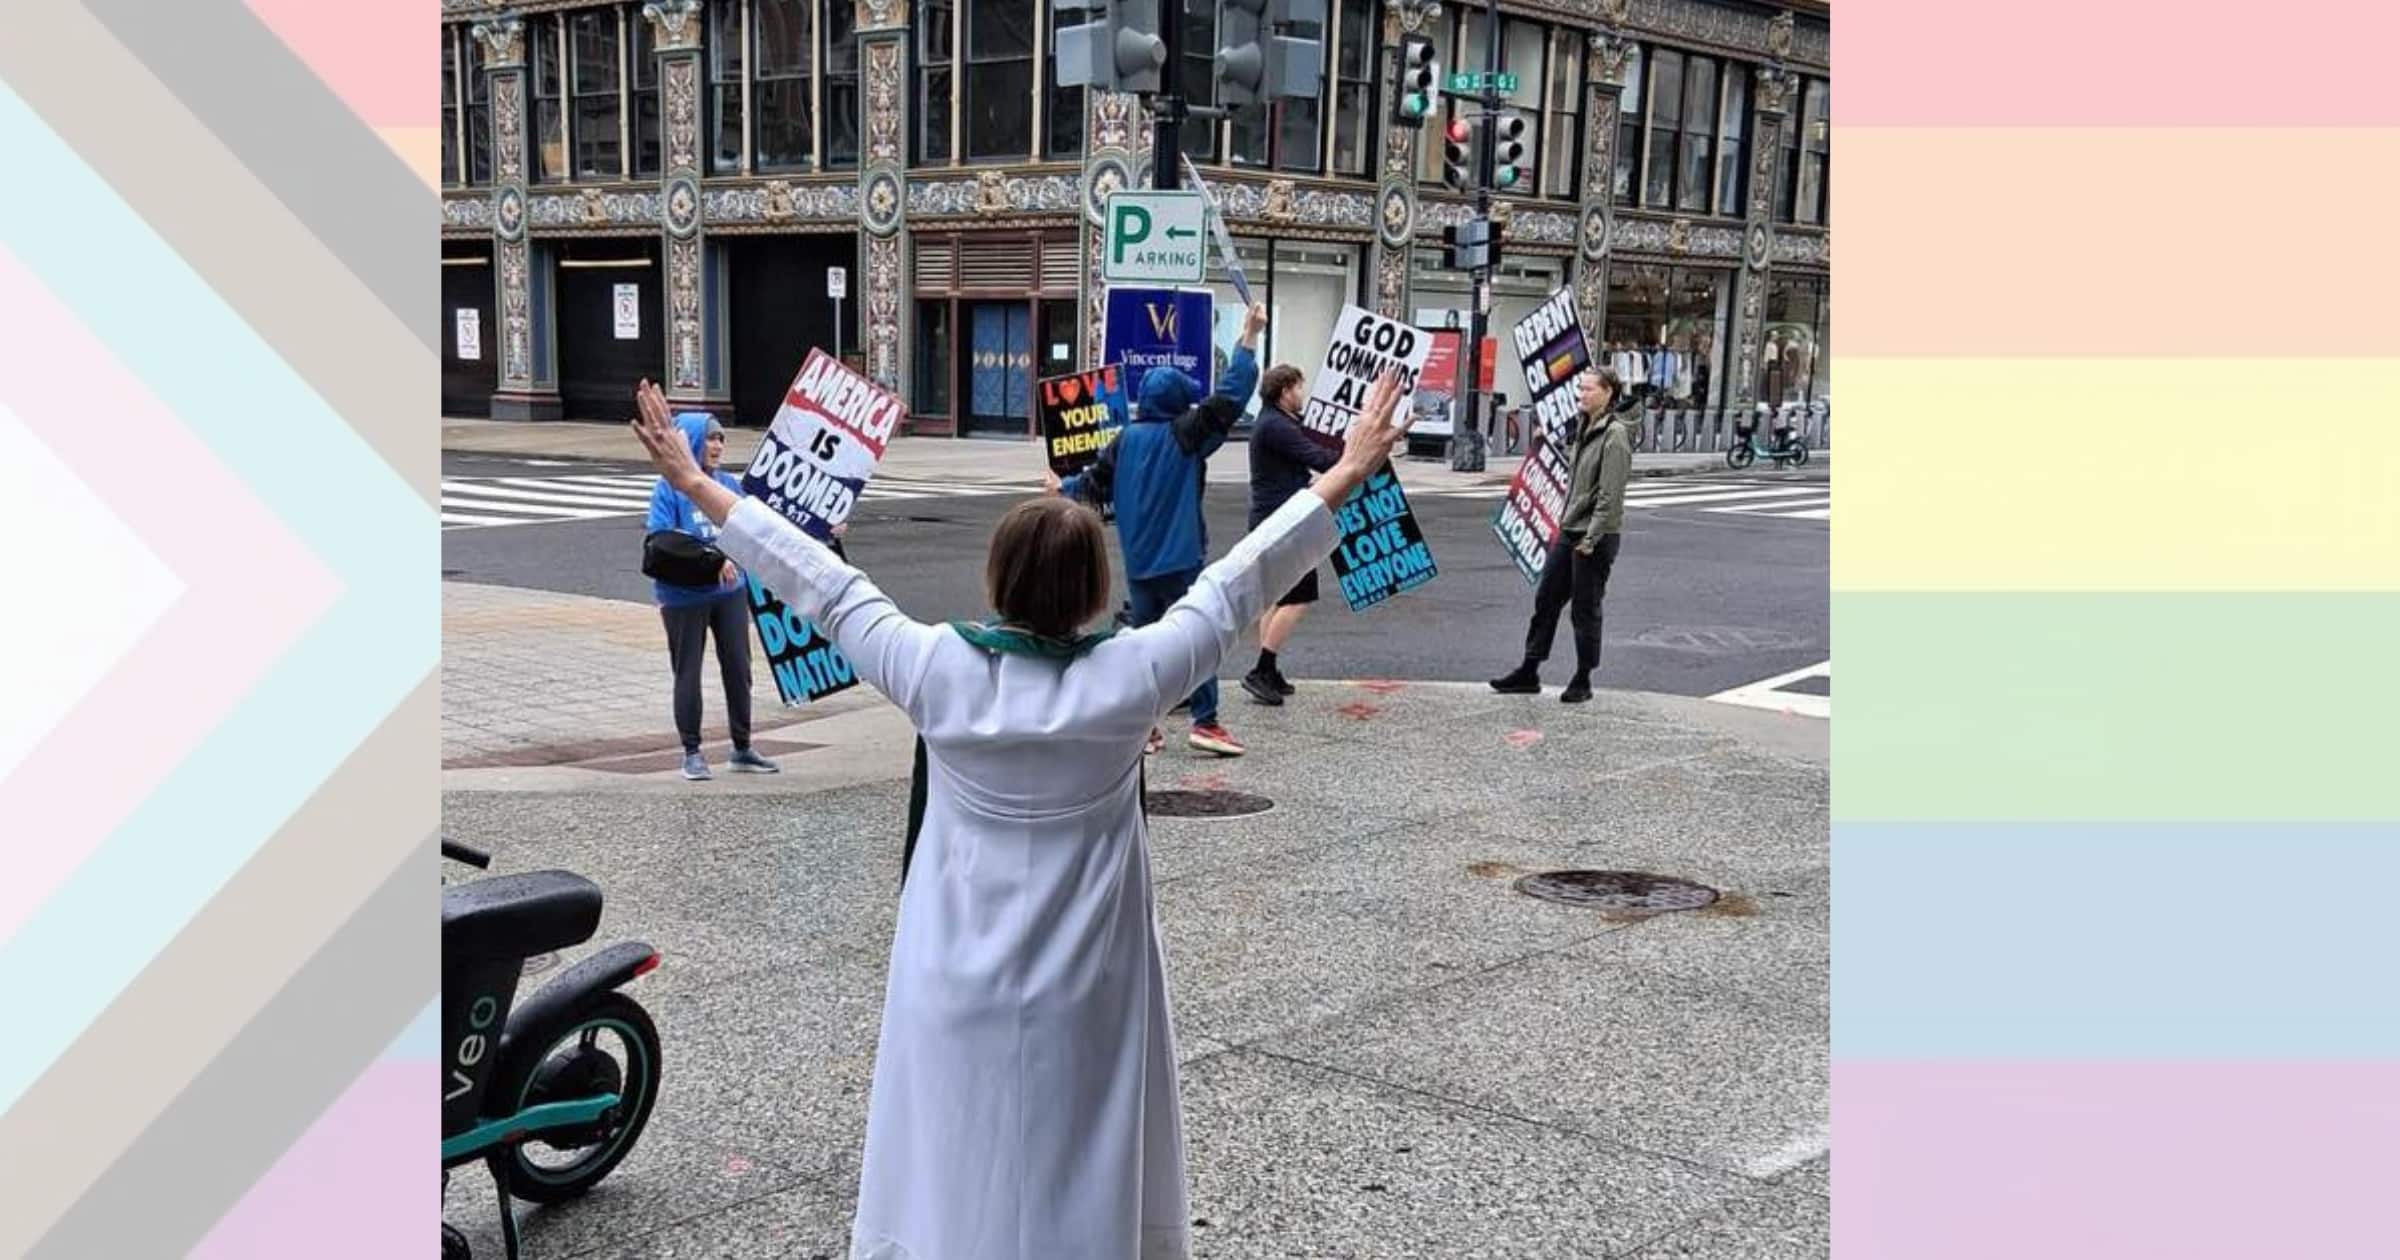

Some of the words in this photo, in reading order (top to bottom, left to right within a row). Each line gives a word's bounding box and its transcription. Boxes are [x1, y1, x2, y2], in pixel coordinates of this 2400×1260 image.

[1354, 315, 1416, 359] GOD
[1514, 289, 1575, 360] REPENT
[795, 353, 901, 447] AMERICA
[1526, 358, 1550, 394] OR
[1060, 403, 1110, 430] YOUR
[810, 428, 841, 462] IS
[750, 437, 854, 527] DOOMED
[1515, 487, 1532, 513] TO
[1551, 461, 1569, 491] NO
[1363, 483, 1407, 523] NOT
[1340, 520, 1408, 570] LOVE
[1500, 500, 1547, 573] WORLD
[1339, 541, 1433, 602] EVERYONE
[774, 645, 853, 702] NATIO
[444, 995, 497, 1102] veo
